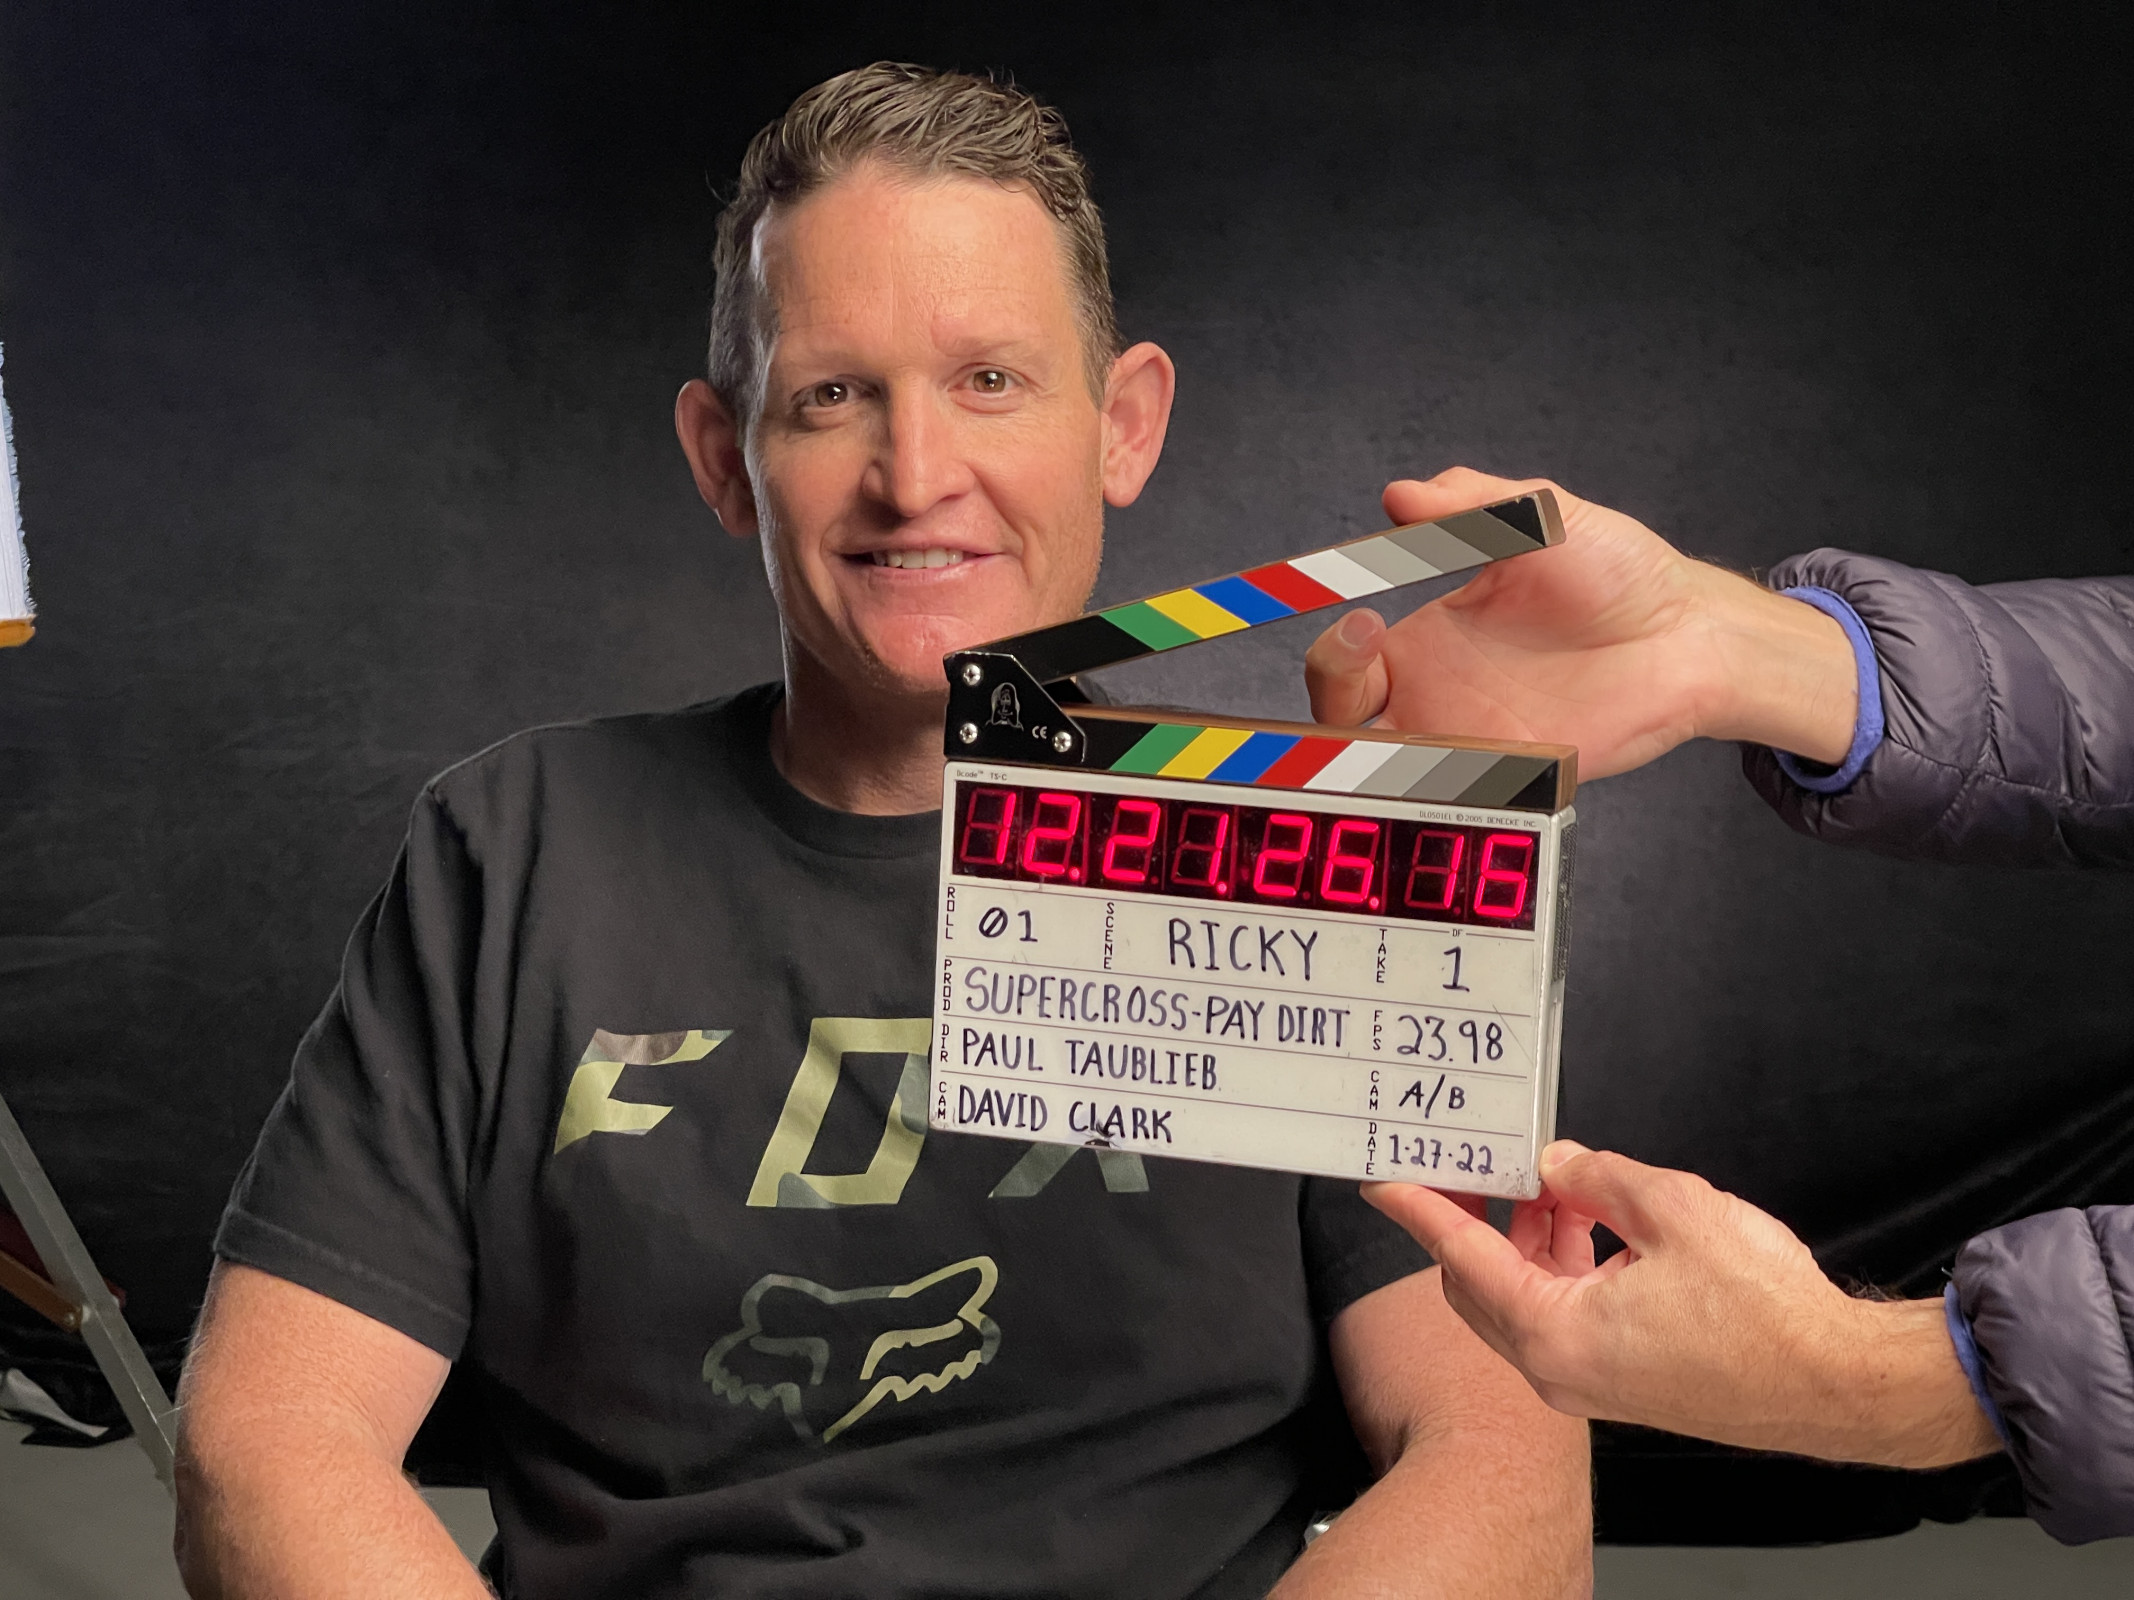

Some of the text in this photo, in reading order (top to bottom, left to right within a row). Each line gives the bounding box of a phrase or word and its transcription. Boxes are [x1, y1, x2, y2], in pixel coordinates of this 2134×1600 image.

[1487, 817, 1519, 826] DENECKE
[945, 887, 956, 940] ROLL
[1103, 902, 1115, 970] SCENE
[1452, 928, 1463, 937] DF
[1169, 917, 1318, 981] RICKY
[1375, 928, 1388, 983] TAKE
[1442, 946, 1470, 992] 1
[942, 958, 952, 1011] PROD
[940, 1023, 950, 1063] DIR
[1277, 1004, 1350, 1048] DIRT
[1372, 1010, 1383, 1051] FPS
[1397, 1015, 1503, 1064] 23.98
[962, 1028, 1218, 1090] PAUL TAUBLIEB
[937, 1081, 947, 1120] CAM
[958, 1084, 1172, 1143] DAVID CLARK
[1369, 1070, 1380, 1111] CAM
[1398, 1073, 1466, 1119] A/B
[1365, 1122, 1377, 1175] DATE
